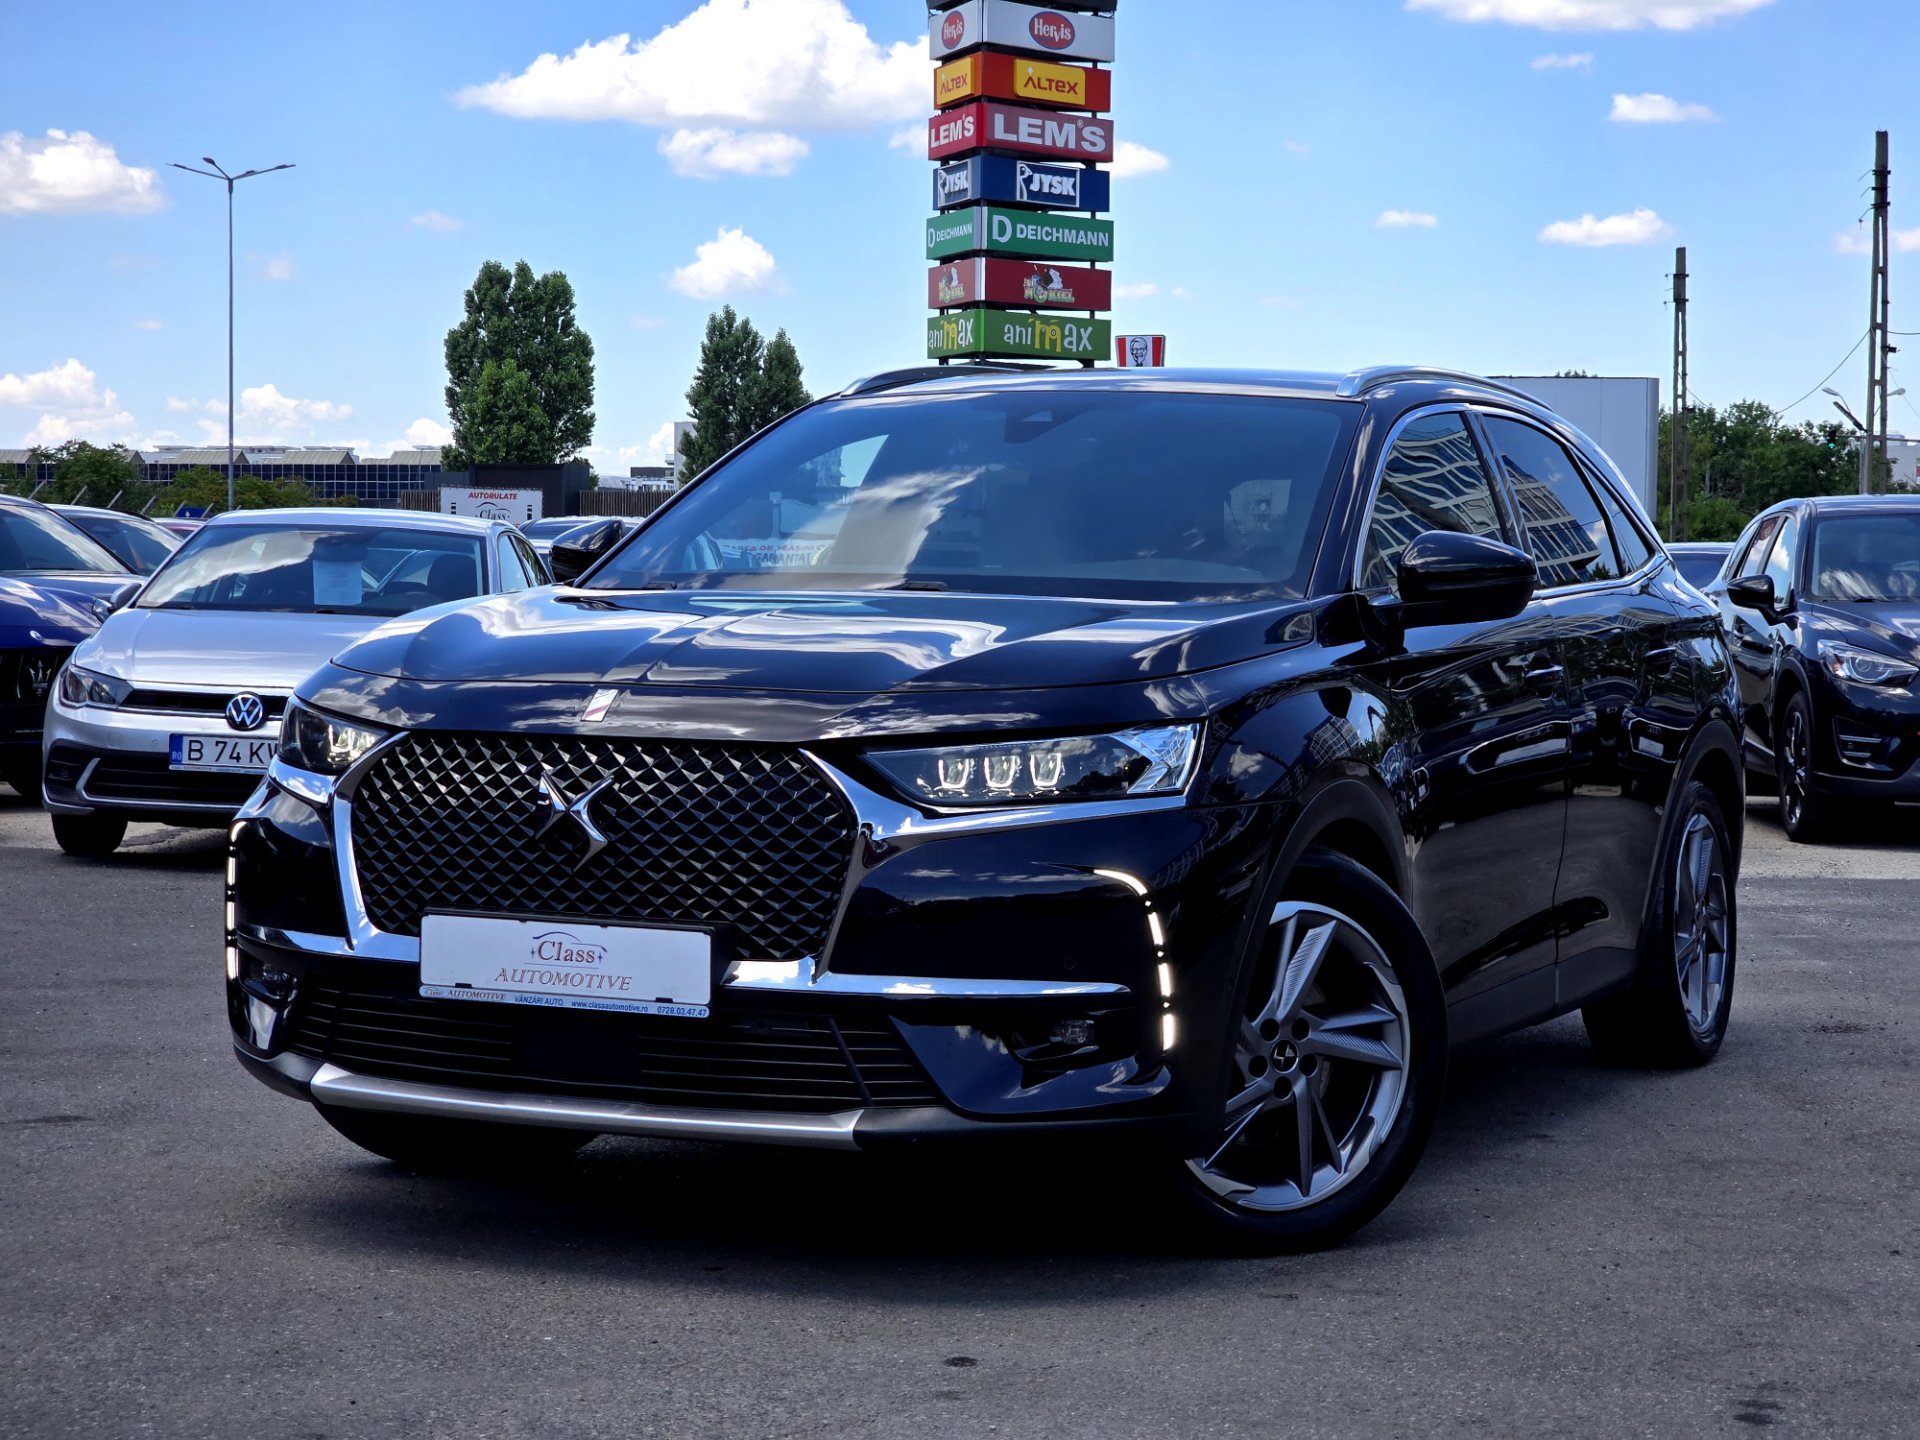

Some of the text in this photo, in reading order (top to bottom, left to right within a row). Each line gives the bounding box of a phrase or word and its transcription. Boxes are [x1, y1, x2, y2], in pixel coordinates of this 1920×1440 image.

[944, 19, 963, 40] Hervis
[1034, 17, 1071, 42] Hervis
[930, 113, 975, 148] LEM'S
[945, 170, 969, 194] JYSK
[1029, 173, 1076, 196] JYSK
[936, 223, 973, 242] DEICHMANN
[992, 215, 1109, 246] D DEICHMANN
[928, 317, 973, 350] animax
[1003, 318, 1093, 353] animax
[468, 492, 518, 500] AUTORULATE
[171, 751, 182, 761] RO
[187, 739, 204, 761] B
[215, 740, 242, 763] 74
[536, 939, 596, 964] Class
[494, 967, 633, 991] AUTOMOTIVE
[447, 990, 507, 1000] AUTOMOTIVE
[571, 1000, 649, 1013] www.classautomotive.ro
[656, 1005, 708, 1017] 0728.03.47.47
